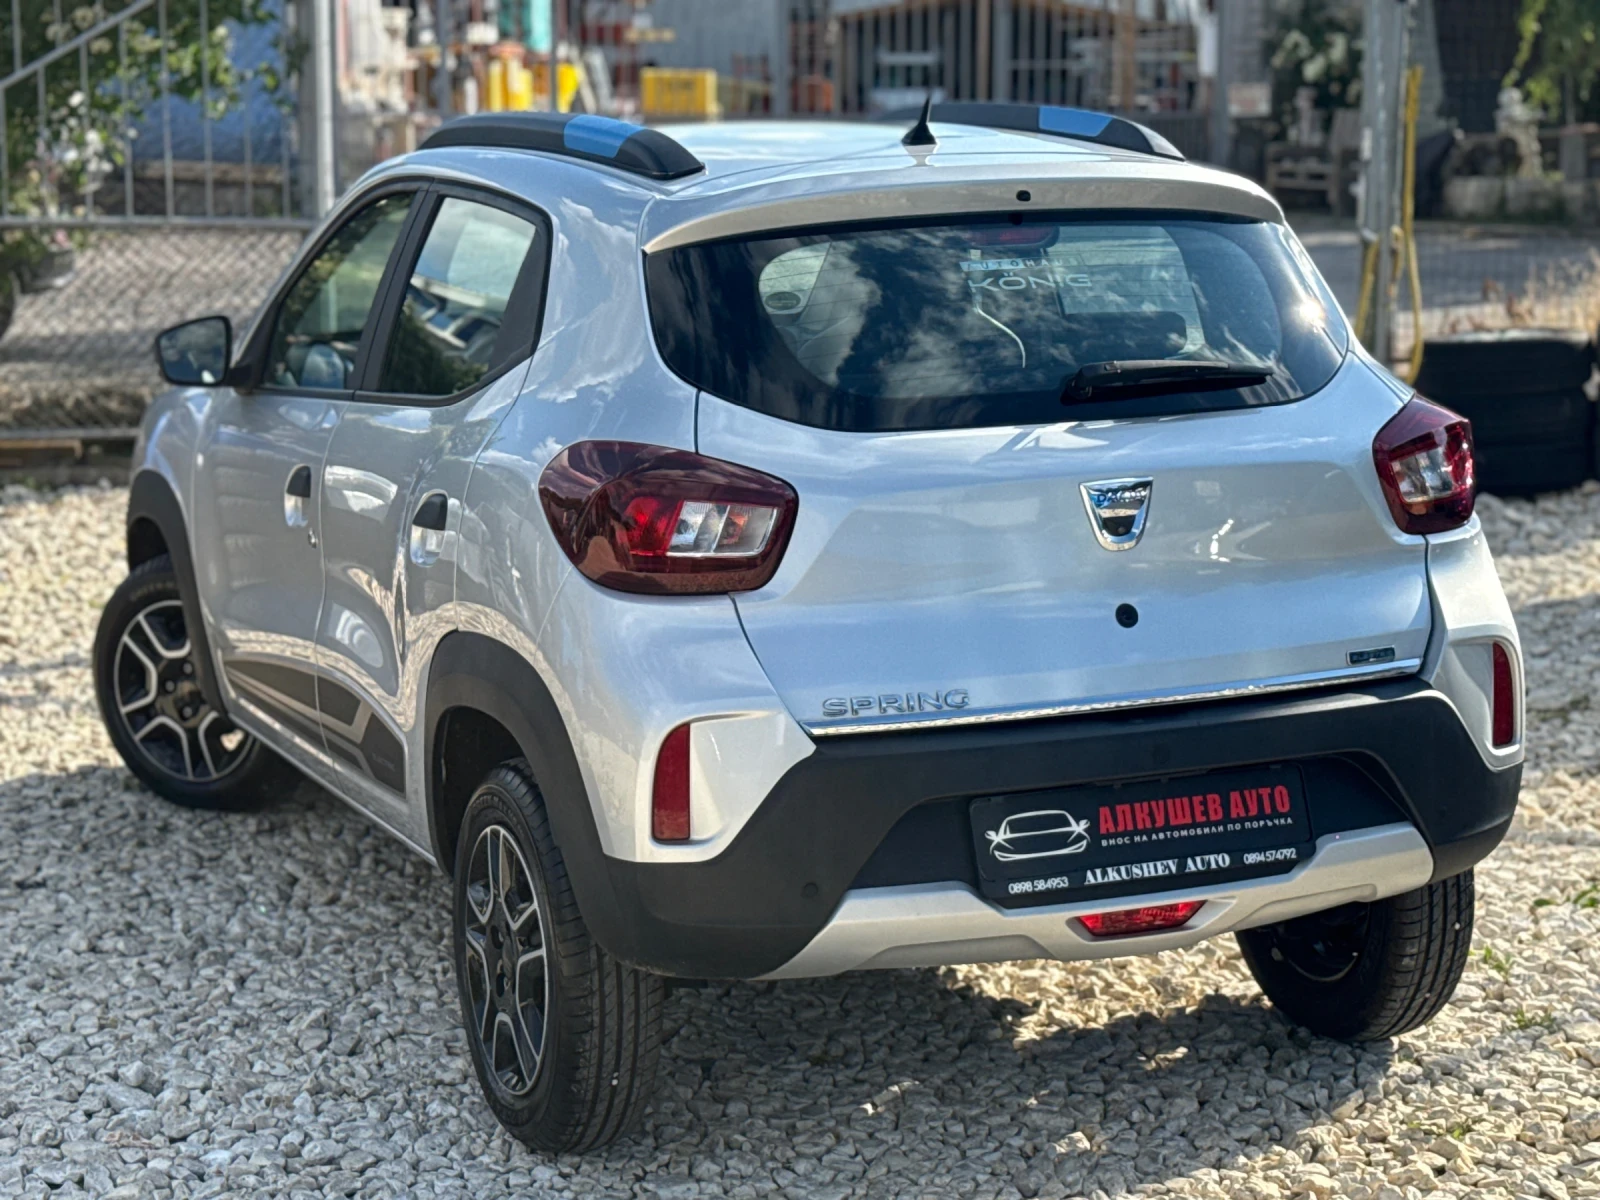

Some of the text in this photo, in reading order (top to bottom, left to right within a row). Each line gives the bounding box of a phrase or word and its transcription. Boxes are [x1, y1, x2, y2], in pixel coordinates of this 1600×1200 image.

[968, 271, 1092, 293] KÖNIG
[822, 688, 970, 717] SPRING
[1099, 785, 1291, 835] АЛКУШЕВ АУТО
[1101, 817, 1294, 847] ВНОС НА АВТОМОБИЛИ ПО ПОРЪЧКА
[1084, 852, 1231, 885] ALKUSHEV AUTO
